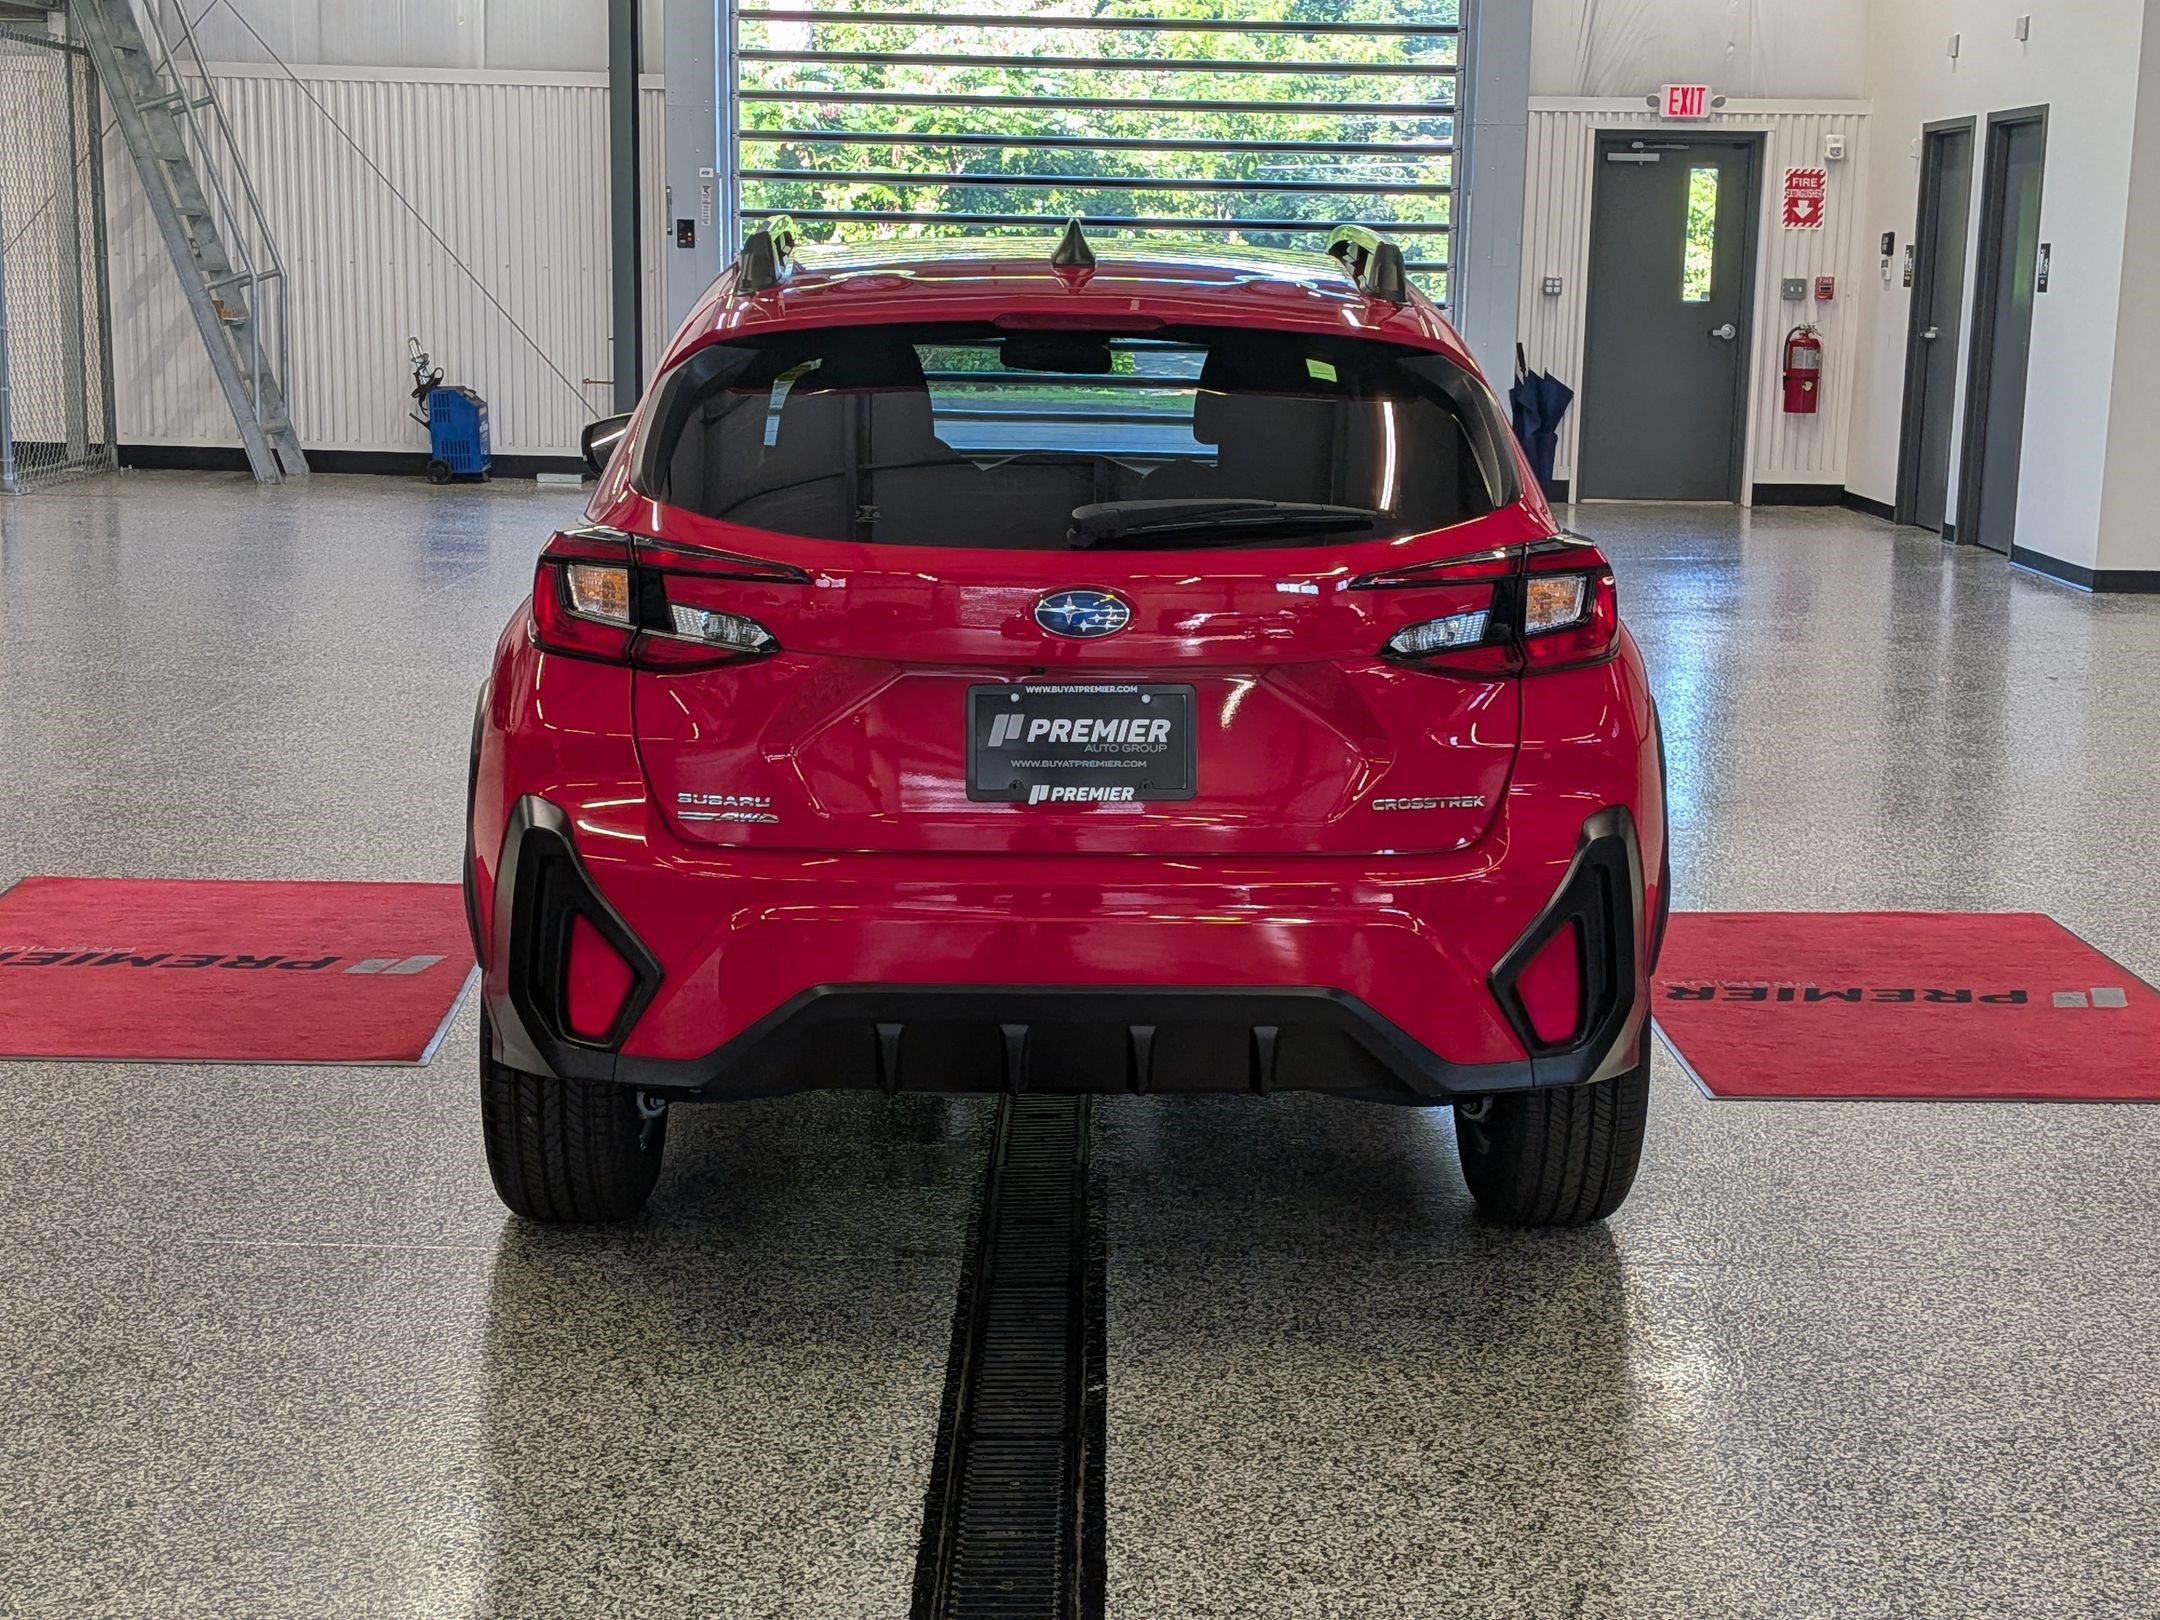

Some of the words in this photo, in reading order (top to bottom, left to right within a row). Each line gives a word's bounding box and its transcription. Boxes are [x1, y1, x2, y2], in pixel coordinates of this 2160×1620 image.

[1668, 87, 1706, 115] EXIT
[1792, 177, 1819, 188] FIRE
[1025, 685, 1138, 694] WWW.BUYATPREMIER.COM
[1026, 718, 1172, 743] PREMIER
[1084, 743, 1119, 753] AUTO
[1122, 744, 1167, 753] GROUP
[1010, 760, 1147, 768] WWW.BUYATPREMIER.COM
[677, 792, 771, 808] SUBARU
[1050, 786, 1135, 801] PREMIER
[1371, 795, 1486, 811] CROSSTREK
[1665, 986, 2028, 1005] PREMIER
